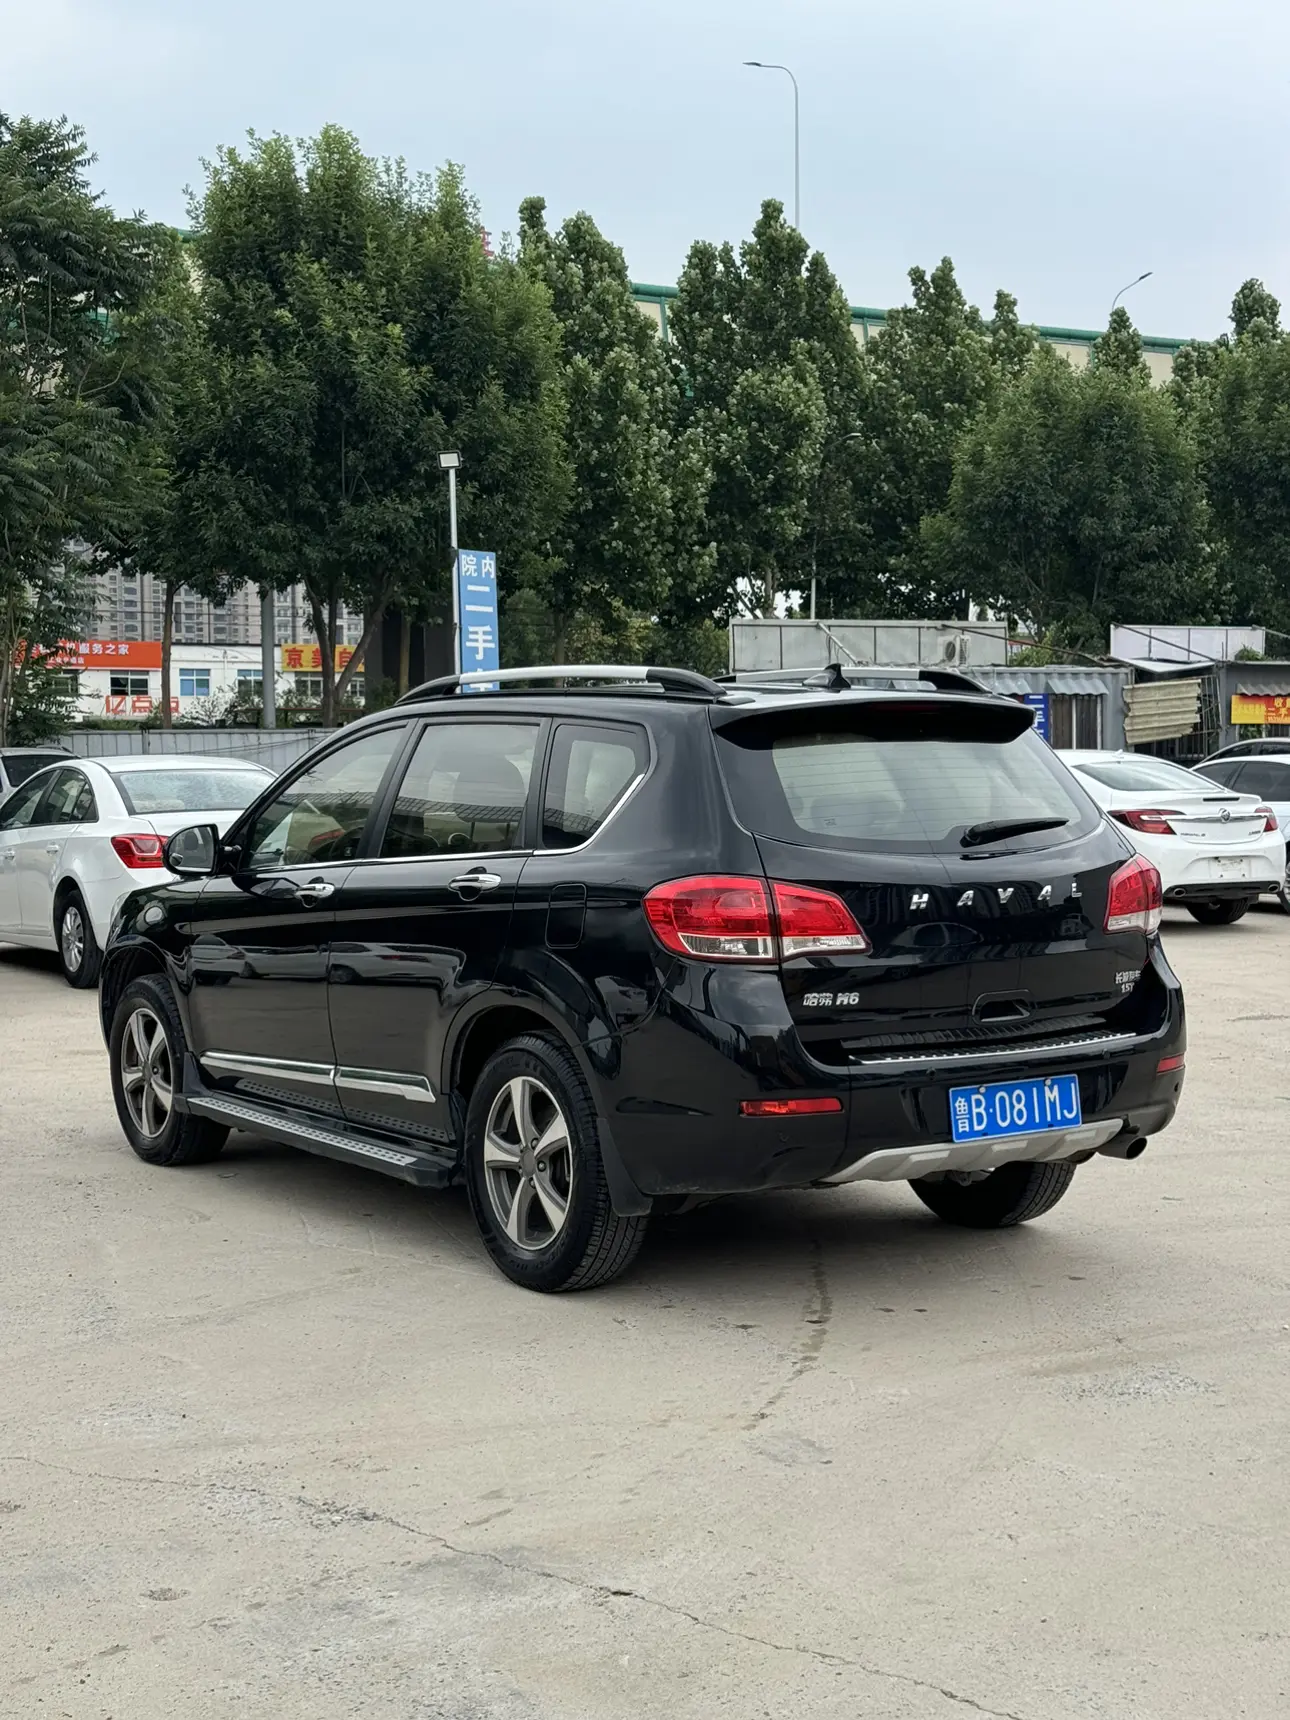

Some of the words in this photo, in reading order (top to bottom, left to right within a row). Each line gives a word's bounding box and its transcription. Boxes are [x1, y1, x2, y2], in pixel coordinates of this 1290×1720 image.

[461, 554, 495, 578] 院内
[910, 883, 1082, 910] HAVAL
[803, 992, 833, 1006] 哈弗
[836, 992, 860, 1005] H6
